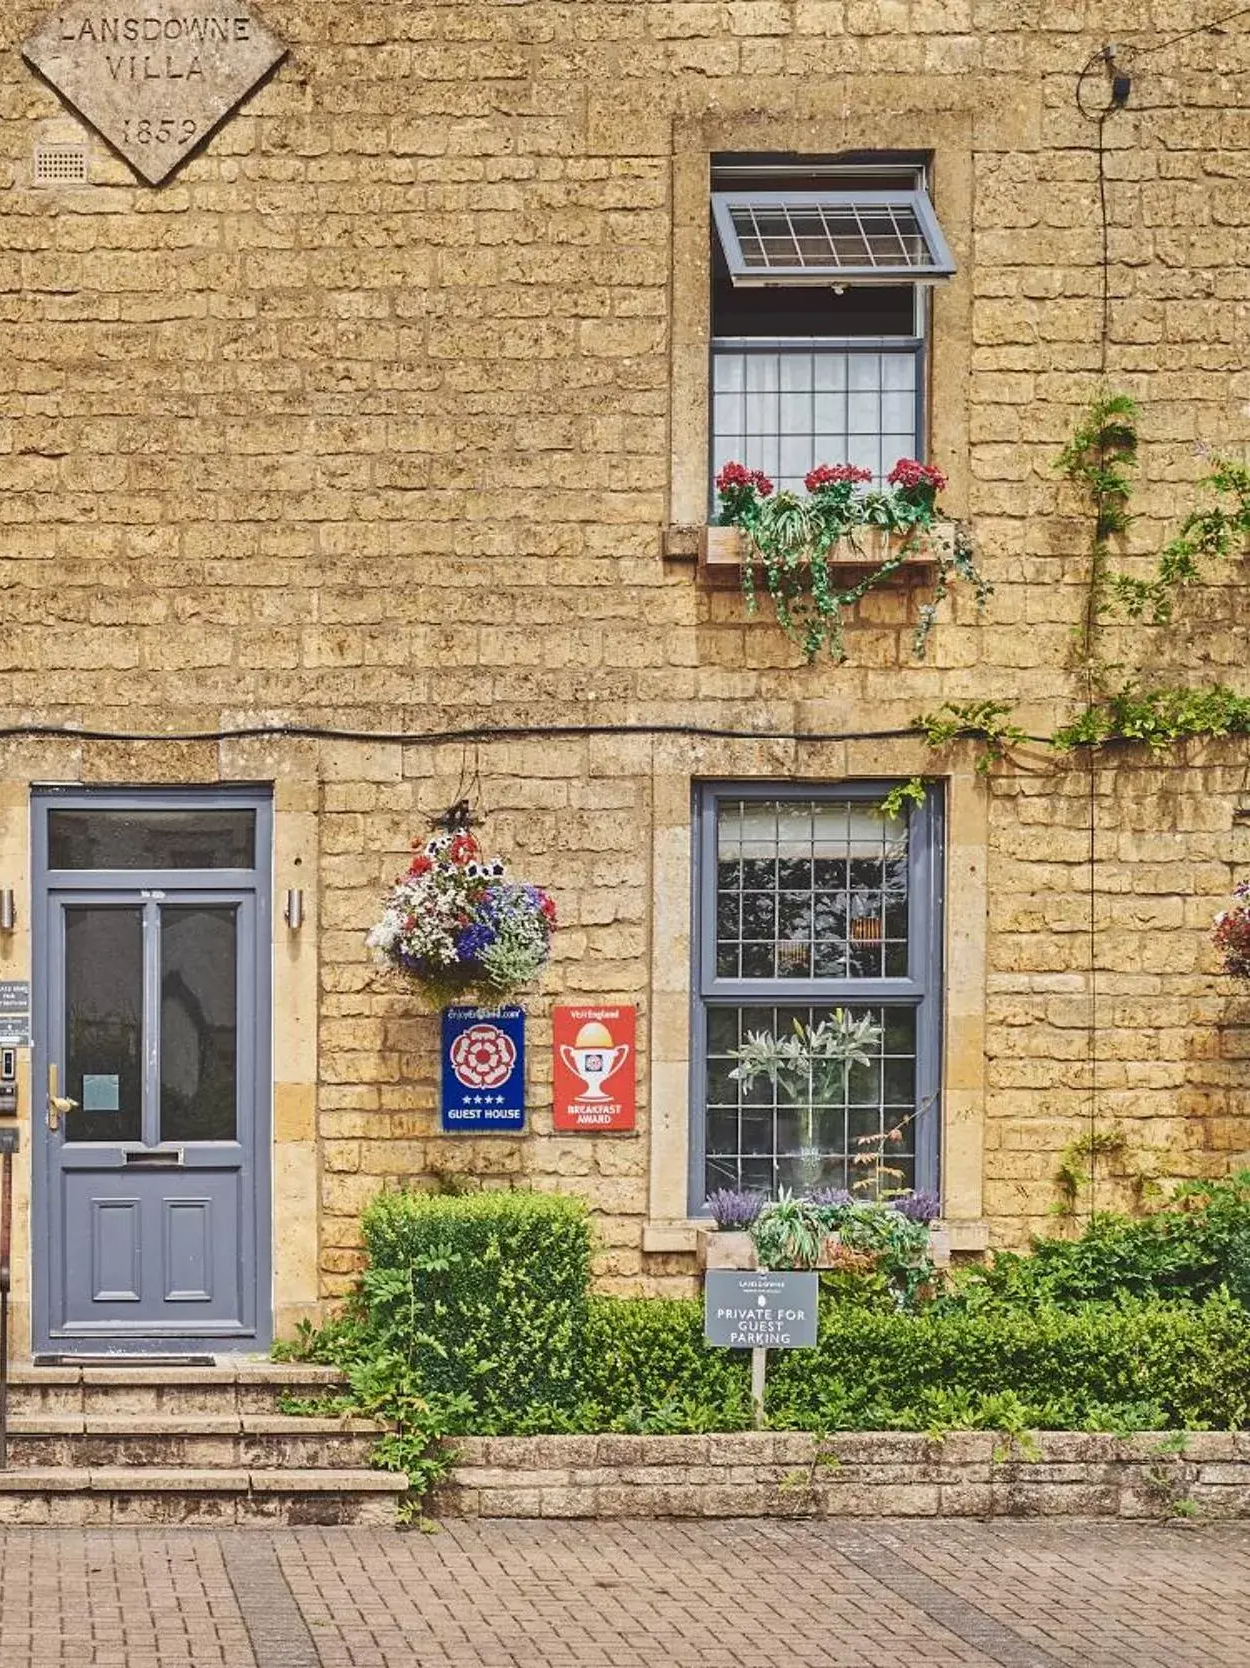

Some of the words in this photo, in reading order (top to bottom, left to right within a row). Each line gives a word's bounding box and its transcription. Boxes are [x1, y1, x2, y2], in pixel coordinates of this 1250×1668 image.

[59, 17, 251, 42] LANSDOWNE
[105, 55, 205, 81] VILLA
[123, 119, 197, 145] 1859
[448, 1109, 483, 1119] GUEST
[484, 1109, 521, 1119] HOUSE
[567, 1104, 623, 1114] BREAKFAST
[577, 1114, 612, 1124] AWARD
[717, 1309, 772, 1320] PRIVATE
[777, 1309, 806, 1321] FOR
[738, 1321, 784, 1332] GUEST
[730, 1332, 791, 1344] PARKING
